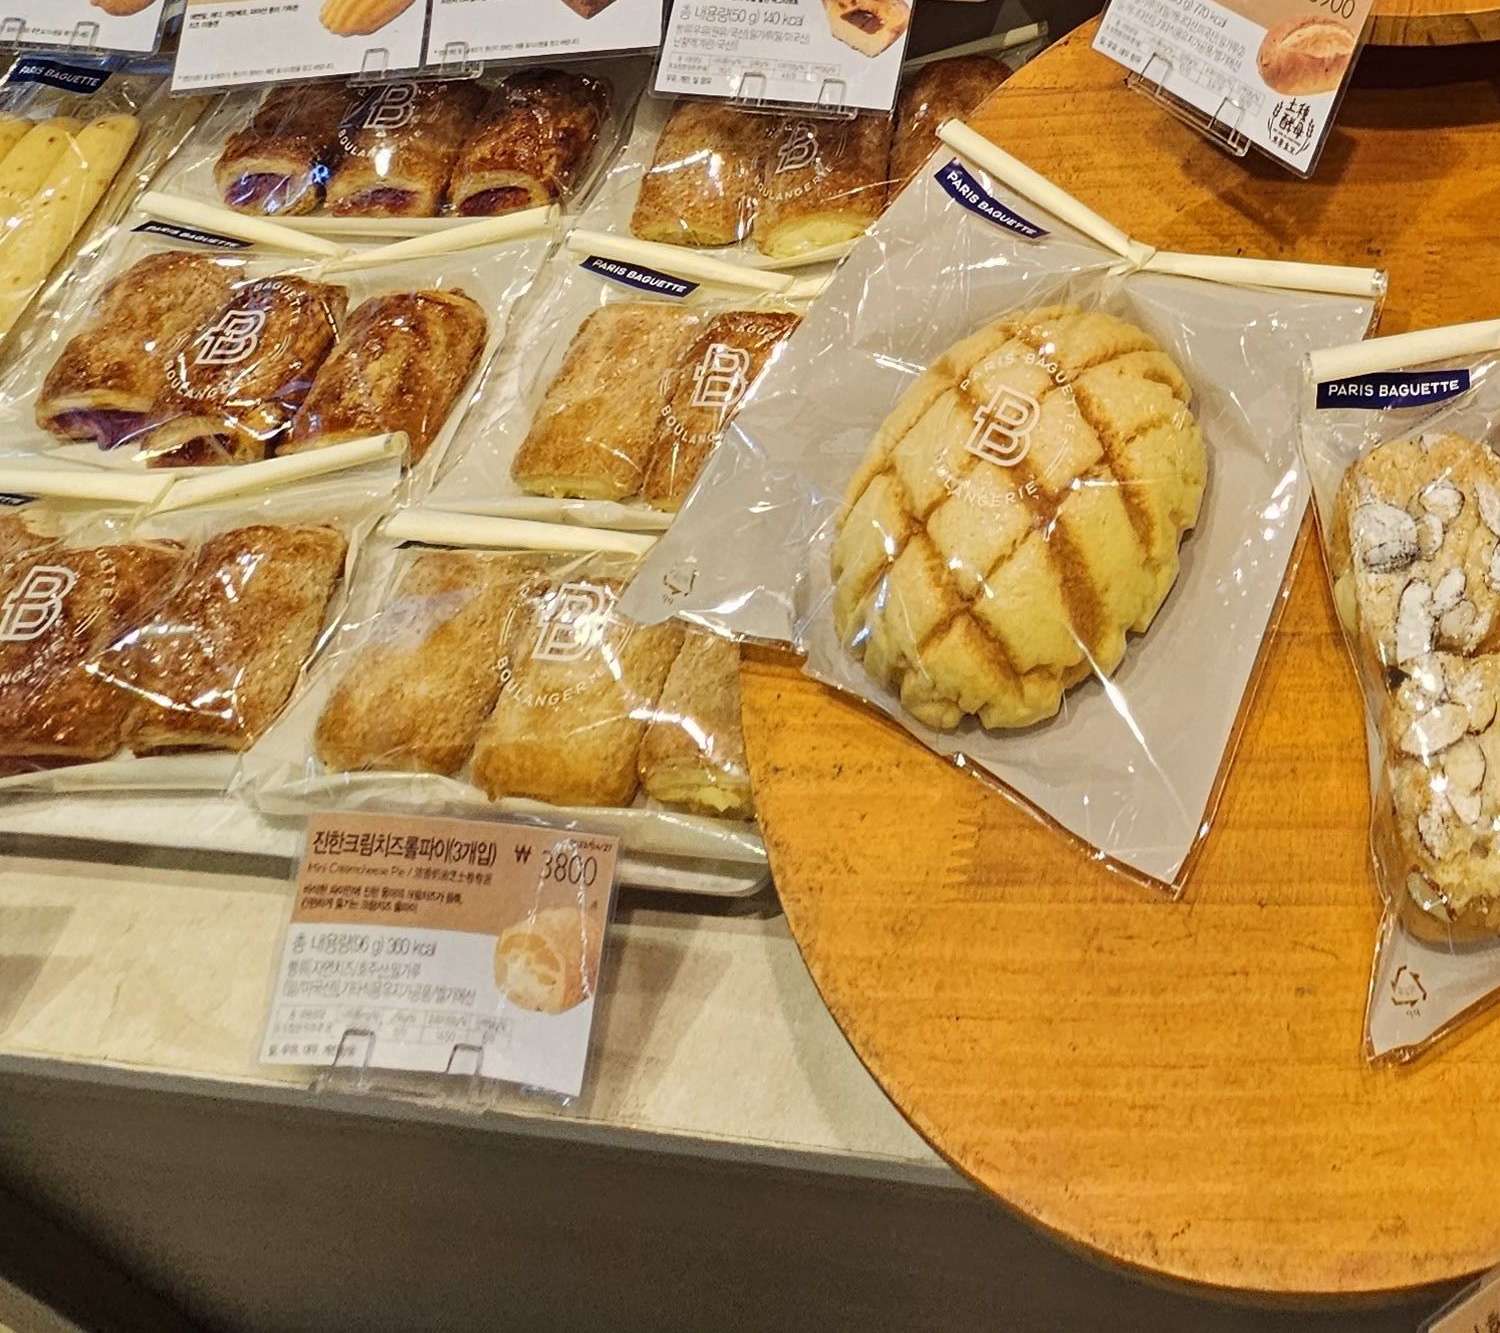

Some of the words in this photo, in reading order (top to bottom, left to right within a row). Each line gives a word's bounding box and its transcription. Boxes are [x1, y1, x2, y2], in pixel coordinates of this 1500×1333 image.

[19, 63, 53, 83] PARIS
[53, 68, 102, 89] BAGUETTE
[944, 165, 983, 204] PARIS
[978, 198, 1042, 239] BAGUETTE
[592, 258, 628, 281] PARIS
[626, 270, 688, 295] BAGUETTE
[1328, 381, 1375, 399] PARIS
[1377, 376, 1461, 397] BAGUETTE
[313, 829, 498, 869] 진한크림치즈롤파이(3개입)
[538, 850, 599, 887] 3800
